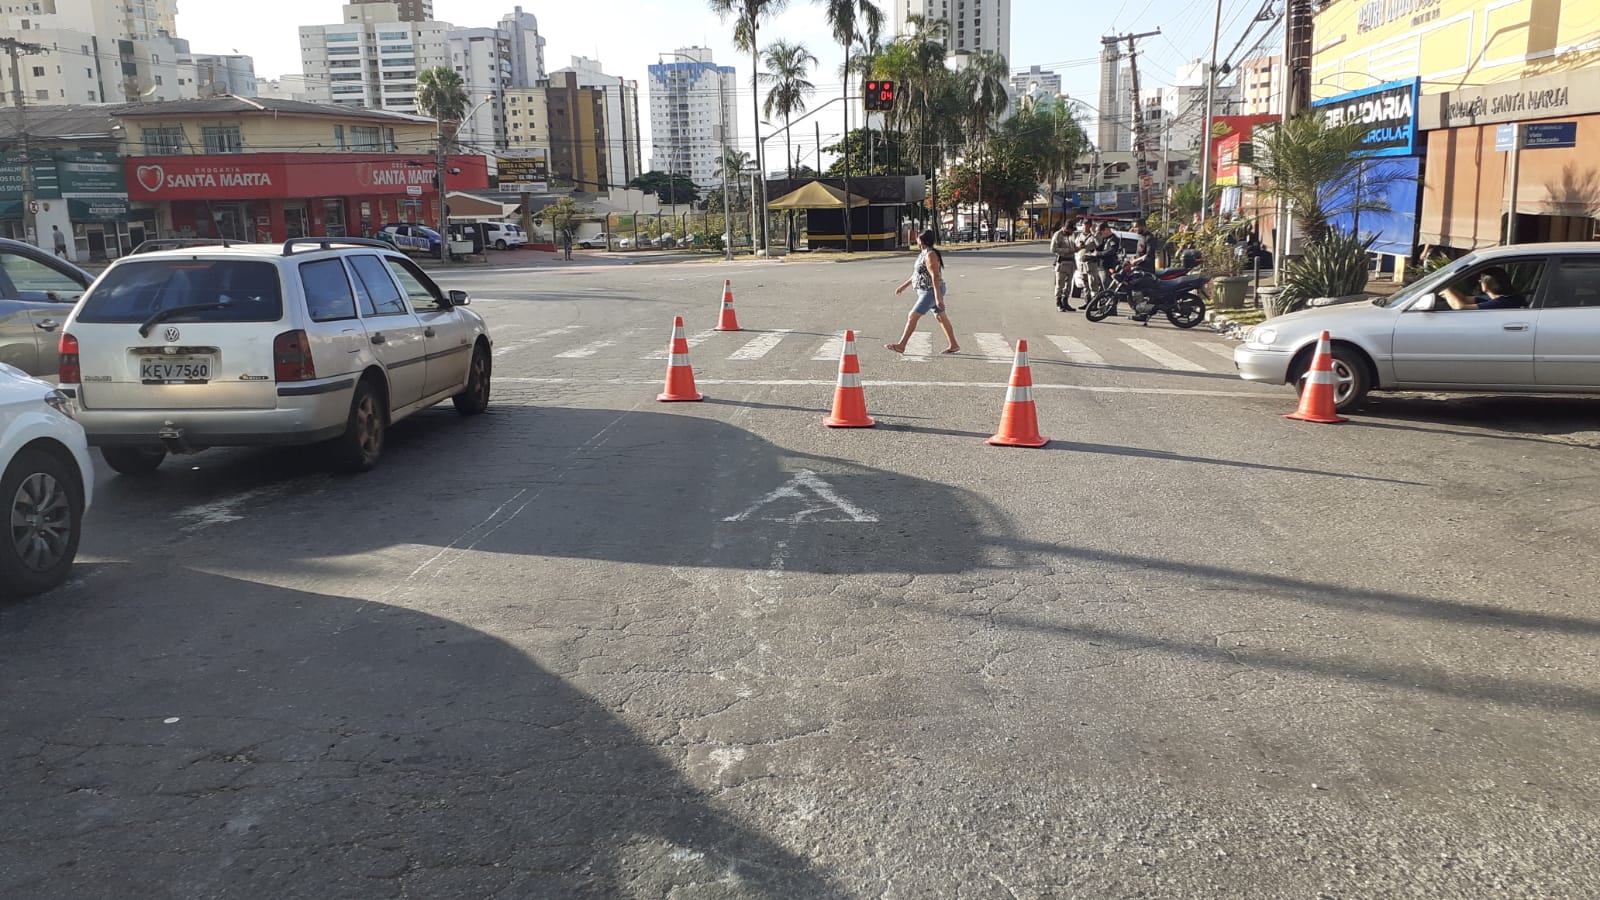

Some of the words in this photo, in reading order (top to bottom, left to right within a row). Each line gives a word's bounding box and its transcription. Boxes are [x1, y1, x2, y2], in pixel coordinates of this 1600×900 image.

[881, 91, 893, 101] 04
[1491, 93, 1525, 114] SANTA
[1528, 87, 1569, 110] MARIA
[1362, 125, 1411, 144] IRCULAR
[167, 174, 217, 188] SANTA
[220, 173, 272, 187] MARTA
[373, 169, 406, 185] SANTA
[143, 365, 173, 377] KEV
[175, 365, 208, 377] 7560
